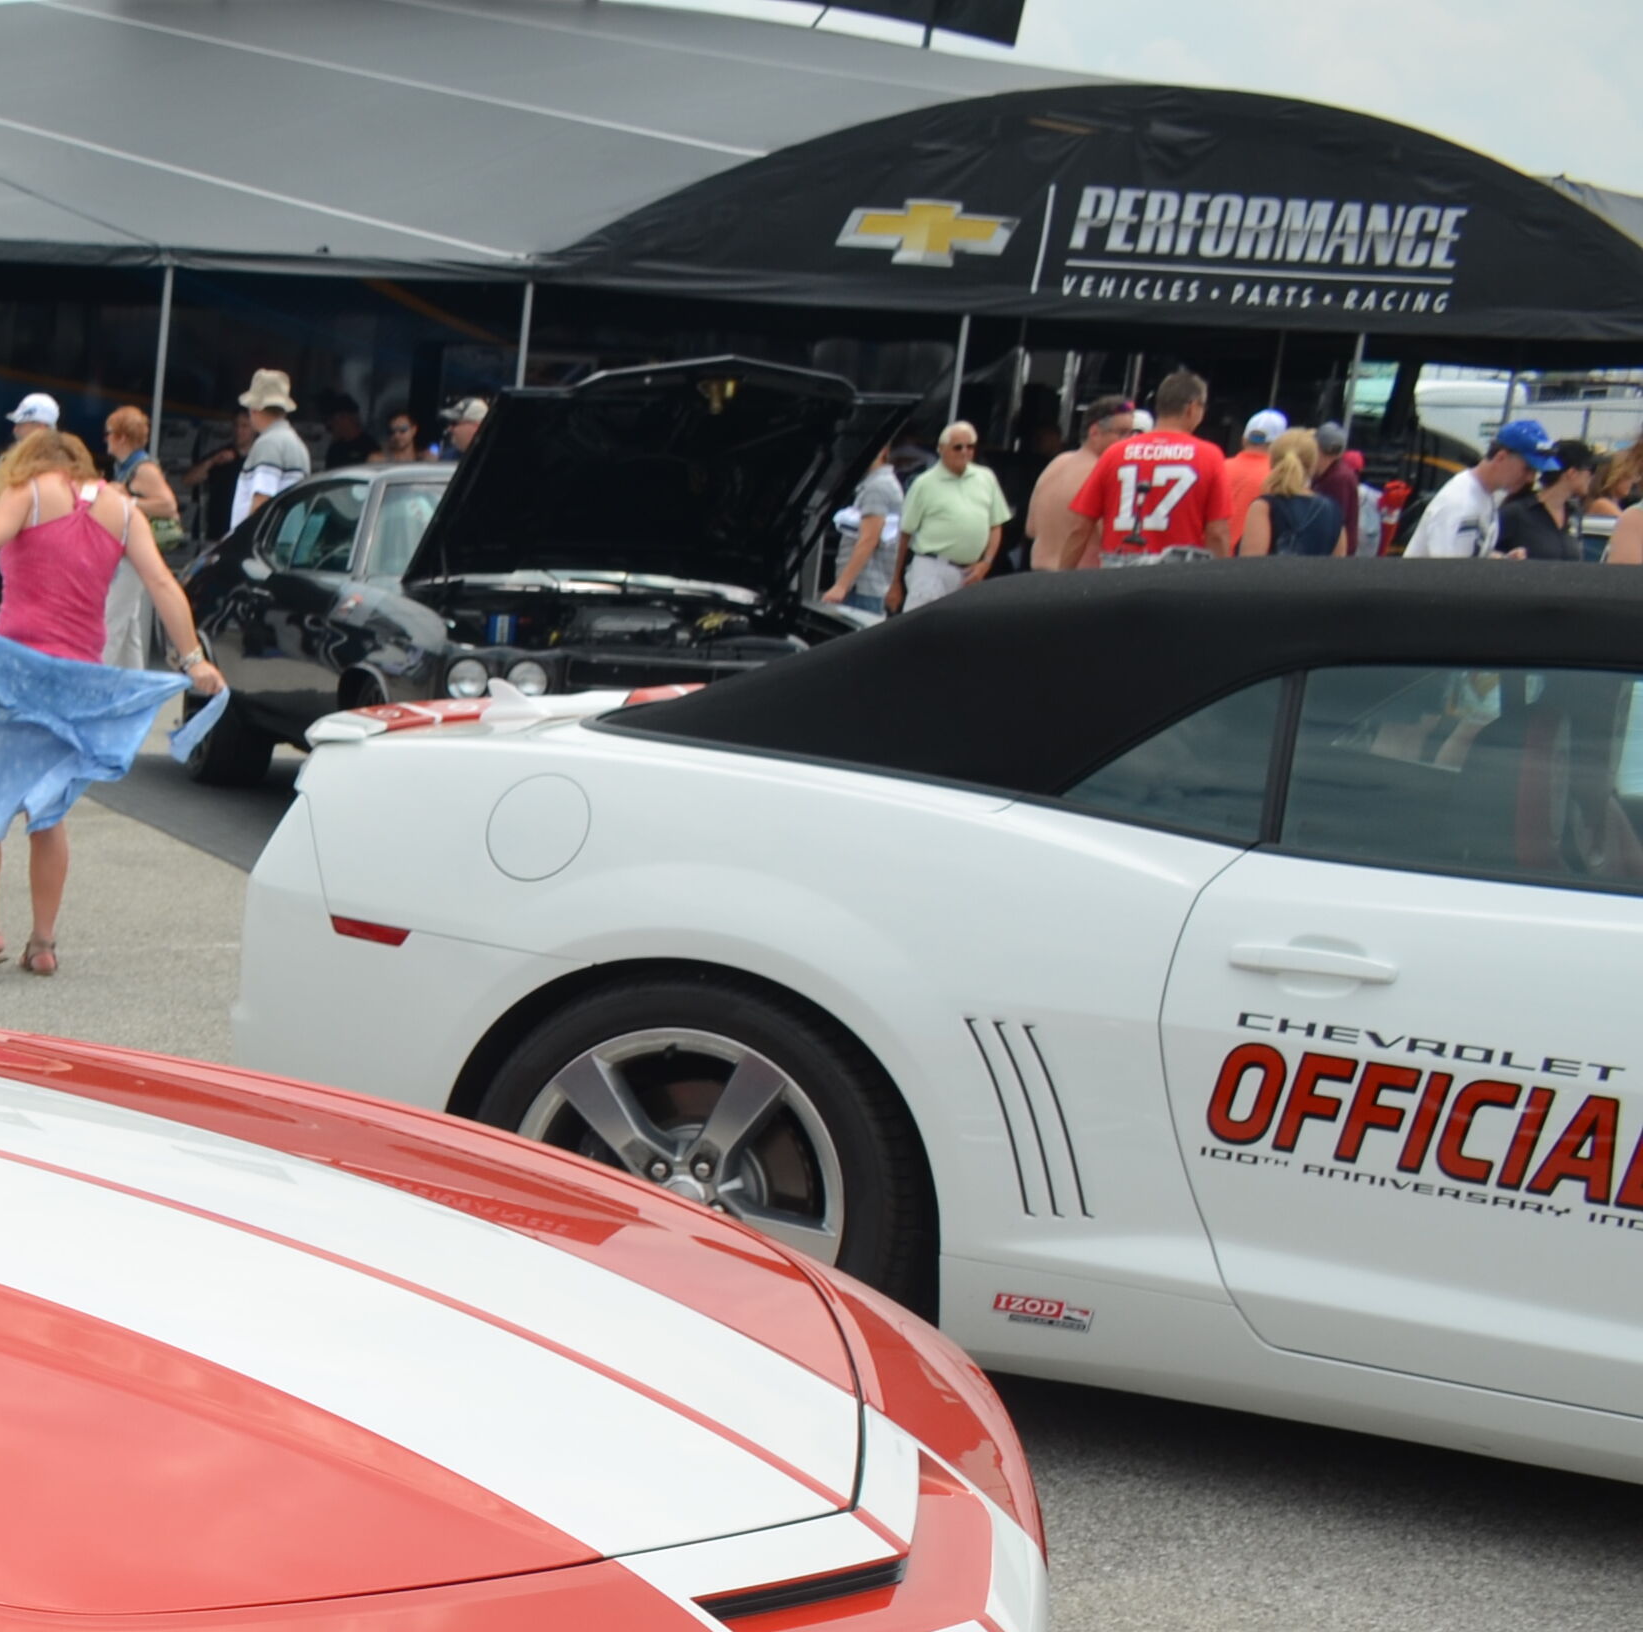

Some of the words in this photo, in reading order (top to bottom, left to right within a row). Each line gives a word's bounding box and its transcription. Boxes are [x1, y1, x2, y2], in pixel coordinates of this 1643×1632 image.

[1068, 185, 1468, 270] PERFORMANCE
[1062, 274, 1200, 302] VEHICLES
[1230, 282, 1313, 308] PARTS
[1342, 288, 1449, 313] RACING
[1123, 443, 1195, 461] SECONDS
[1113, 464, 1198, 532] 17
[1236, 1011, 1626, 1082] CHEVROLET
[1301, 1164, 1572, 1218] ANNIVERSARY
[998, 1295, 1059, 1316] IZOD
